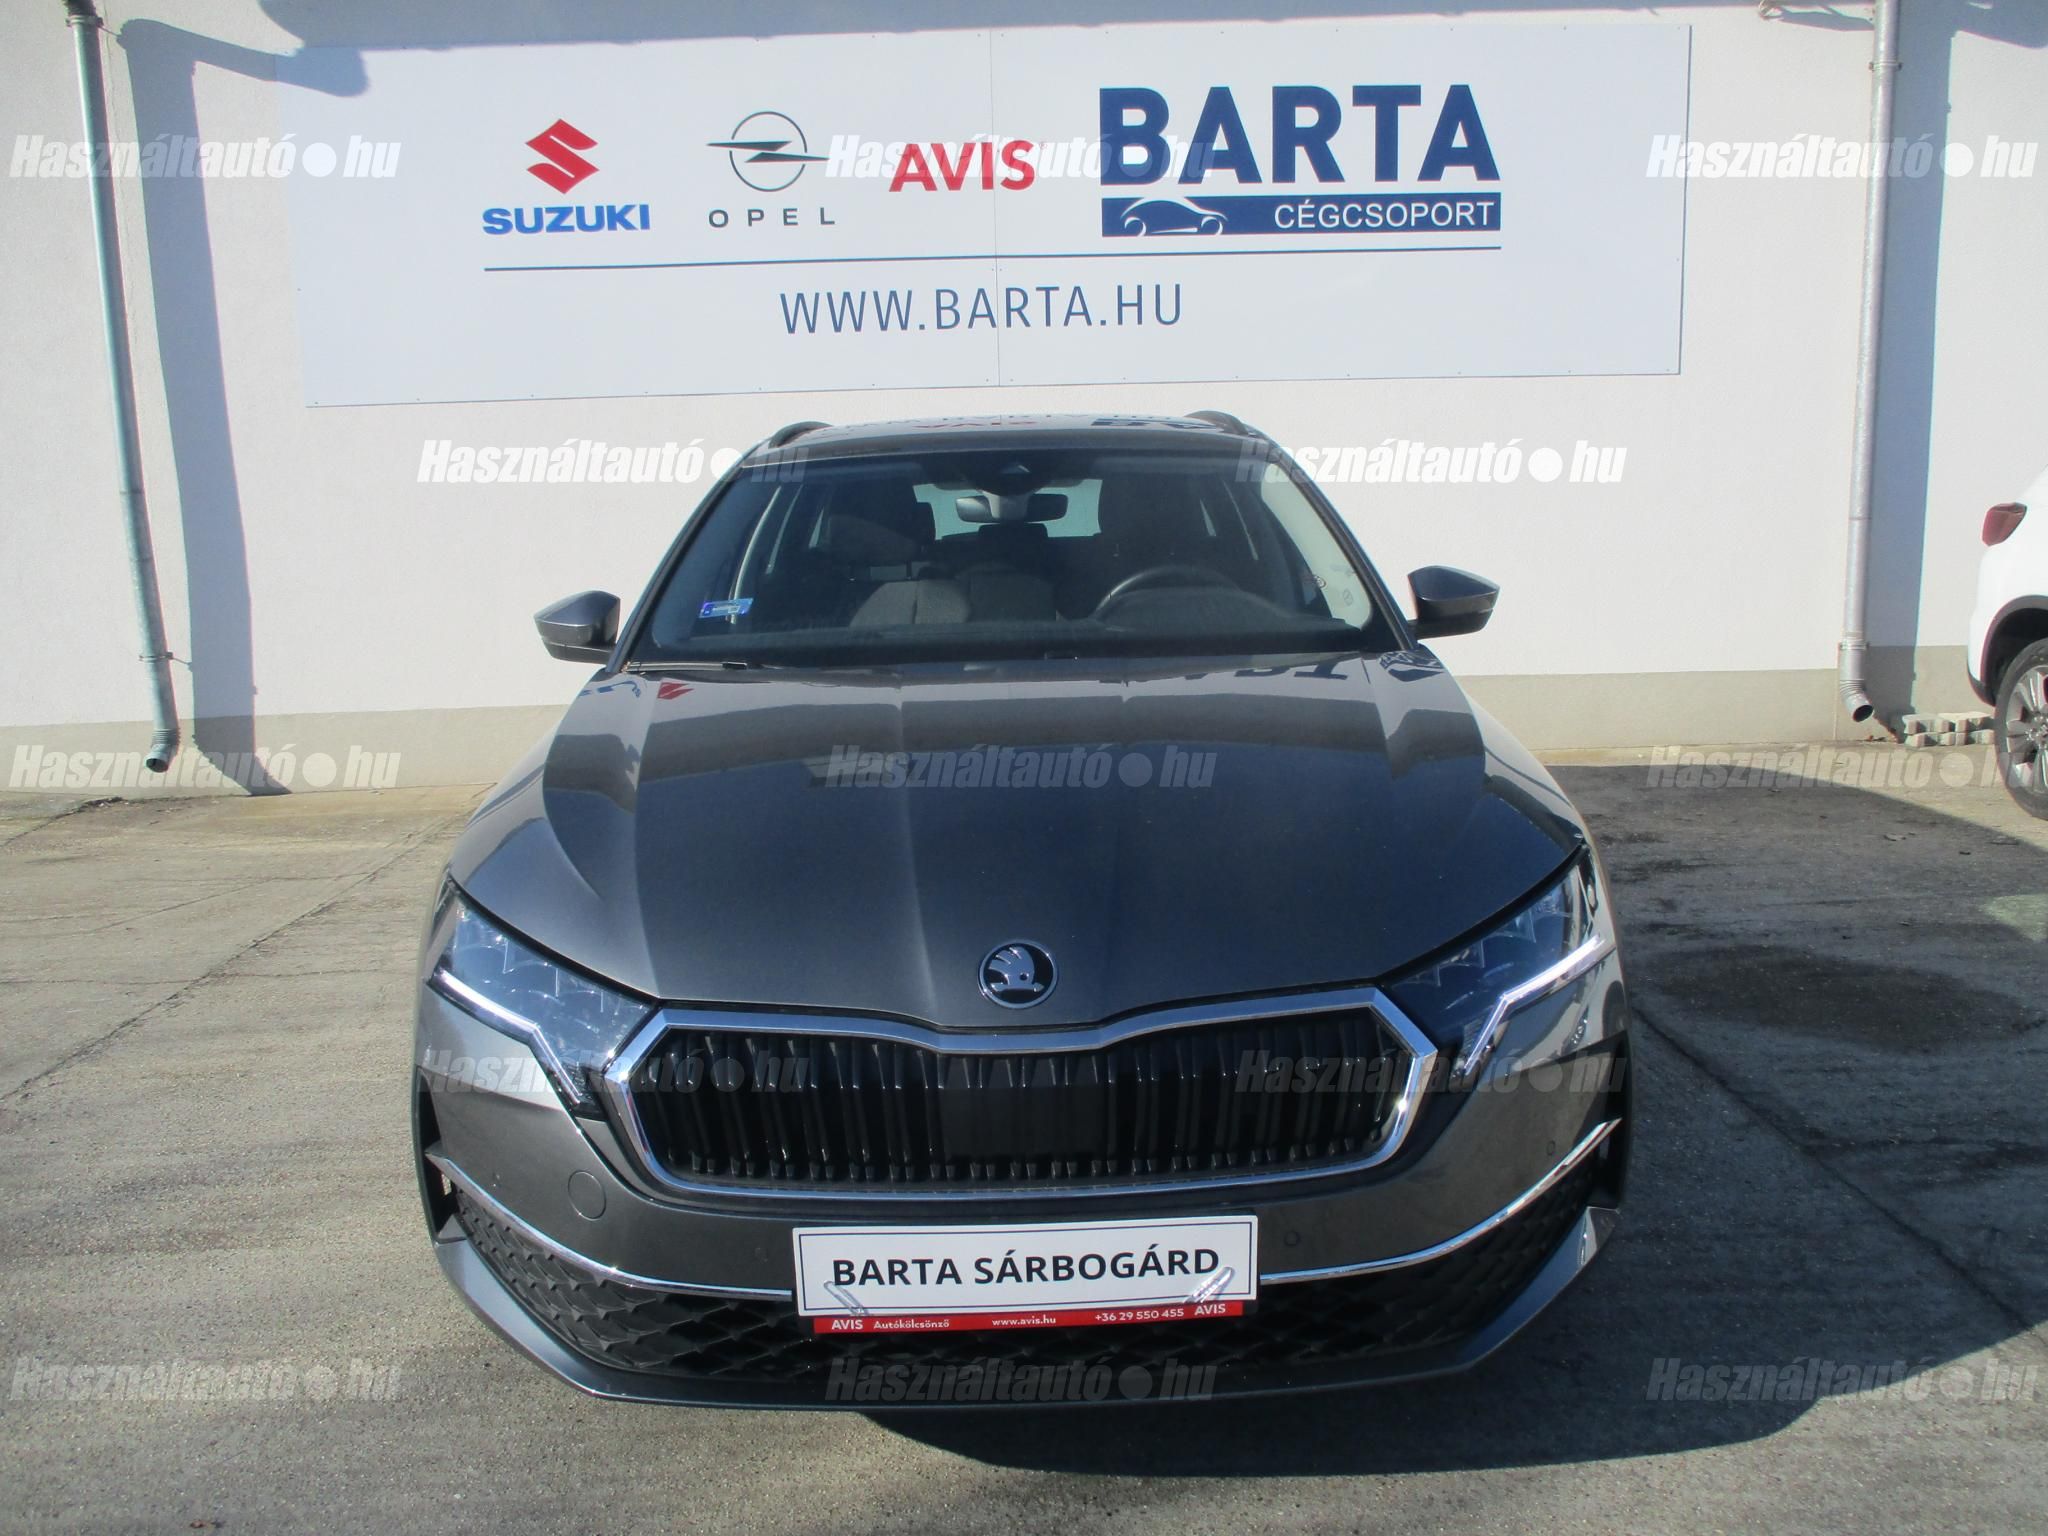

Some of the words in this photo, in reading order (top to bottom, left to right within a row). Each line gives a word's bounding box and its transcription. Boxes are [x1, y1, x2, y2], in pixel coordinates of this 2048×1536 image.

[1100, 84, 1500, 186] BARTA
[888, 139, 1036, 192] AVIS
[482, 203, 651, 236] SUZUKI
[708, 206, 836, 229] OPEL
[1273, 196, 1495, 230] CÉGCSOPORT
[780, 283, 1183, 335] WWW.BARTA.HU
[833, 1258, 963, 1286] BARTA
[974, 1243, 1220, 1284] SÁRBOGÁRD
[831, 1319, 863, 1330] AVIS
[992, 1315, 1057, 1327] www.avis.hu
[1095, 1312, 1116, 1322] +36
[1119, 1311, 1132, 1321] 29
[1136, 1310, 1159, 1320] 550
[1161, 1308, 1184, 1318] 455
[1194, 1303, 1226, 1316] AVIS
